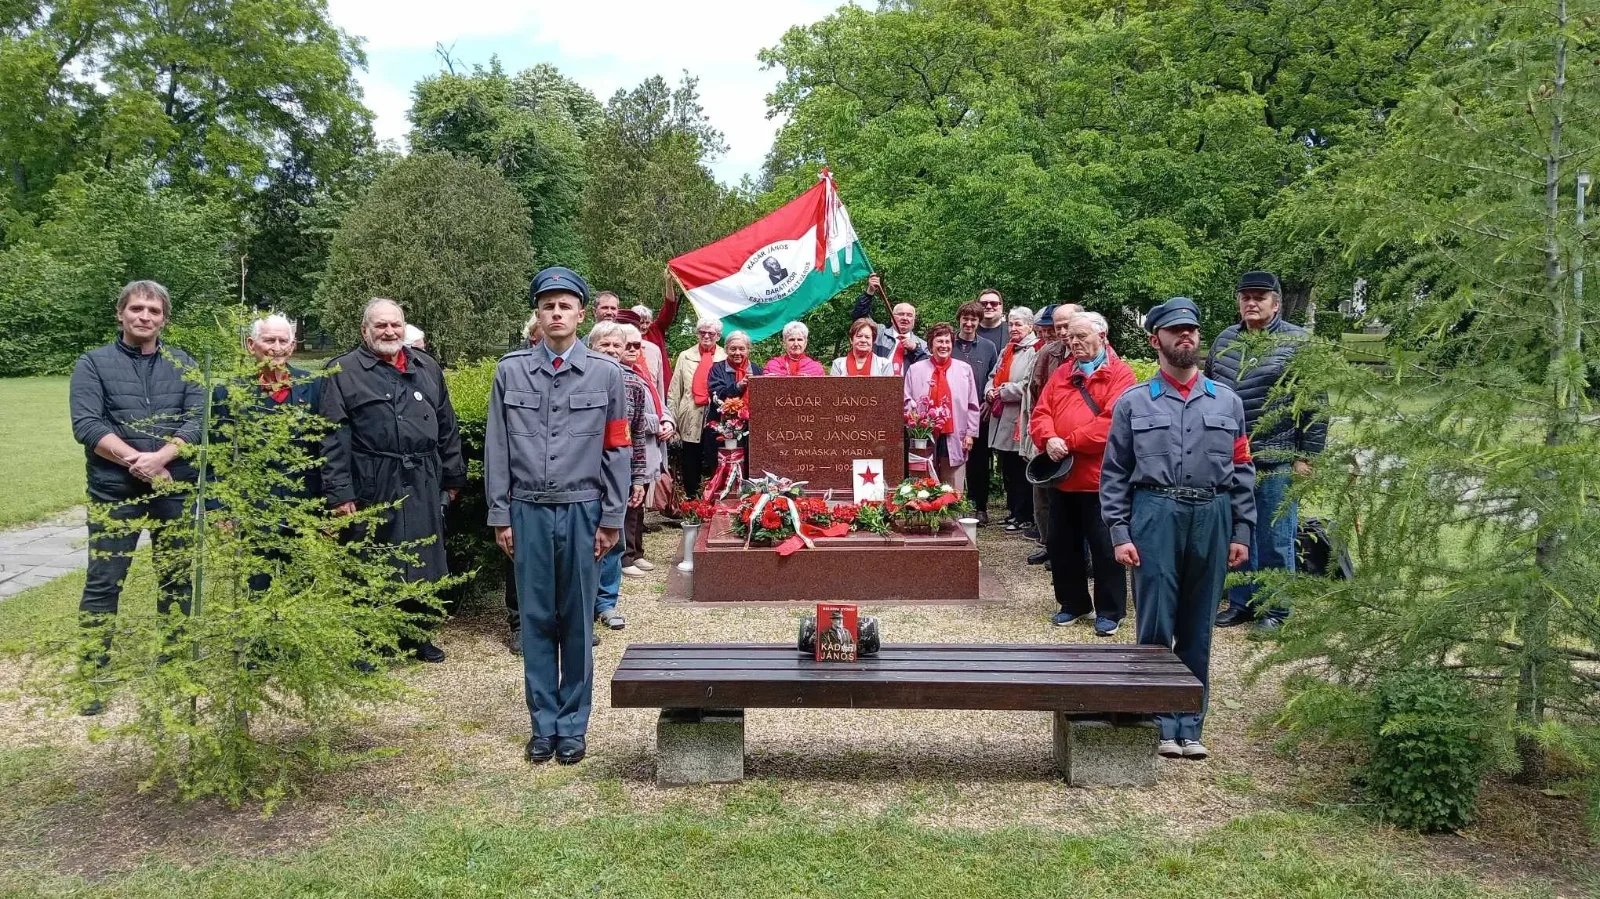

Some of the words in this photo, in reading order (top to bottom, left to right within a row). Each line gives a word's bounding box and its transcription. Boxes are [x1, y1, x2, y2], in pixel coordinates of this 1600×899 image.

[775, 393, 822, 407] KÁDÁR
[832, 393, 878, 407] JÁNOS
[797, 414, 815, 423] 1912
[835, 414, 856, 423] 1989
[766, 428, 813, 441] KÁDÁR
[823, 428, 886, 441] JÁNOSNÉ
[793, 446, 838, 456] TAMÁSKA
[842, 446, 873, 456] MÁRIA
[797, 463, 815, 472] 1912
[821, 651, 855, 661] JÁNOS
